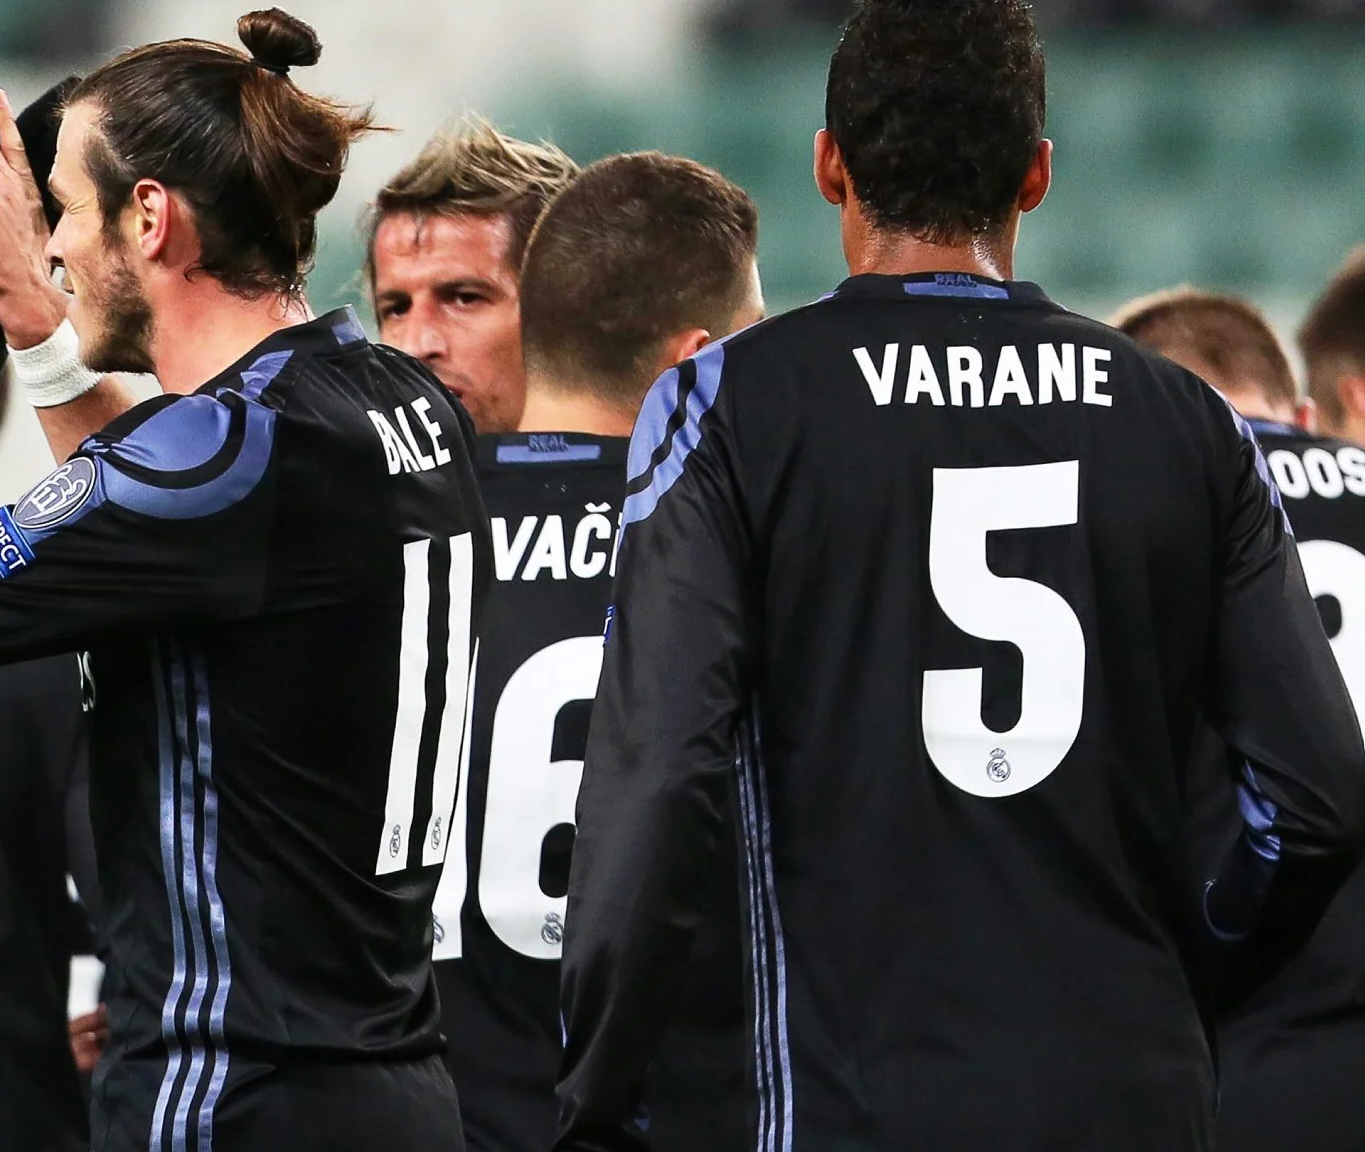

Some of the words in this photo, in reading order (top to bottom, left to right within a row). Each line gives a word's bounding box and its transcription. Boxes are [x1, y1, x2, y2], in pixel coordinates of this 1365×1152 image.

[366, 396, 452, 475] BALE
[852, 343, 1113, 408] VARANE
[375, 530, 473, 876] 11
[921, 459, 1086, 798] 5
